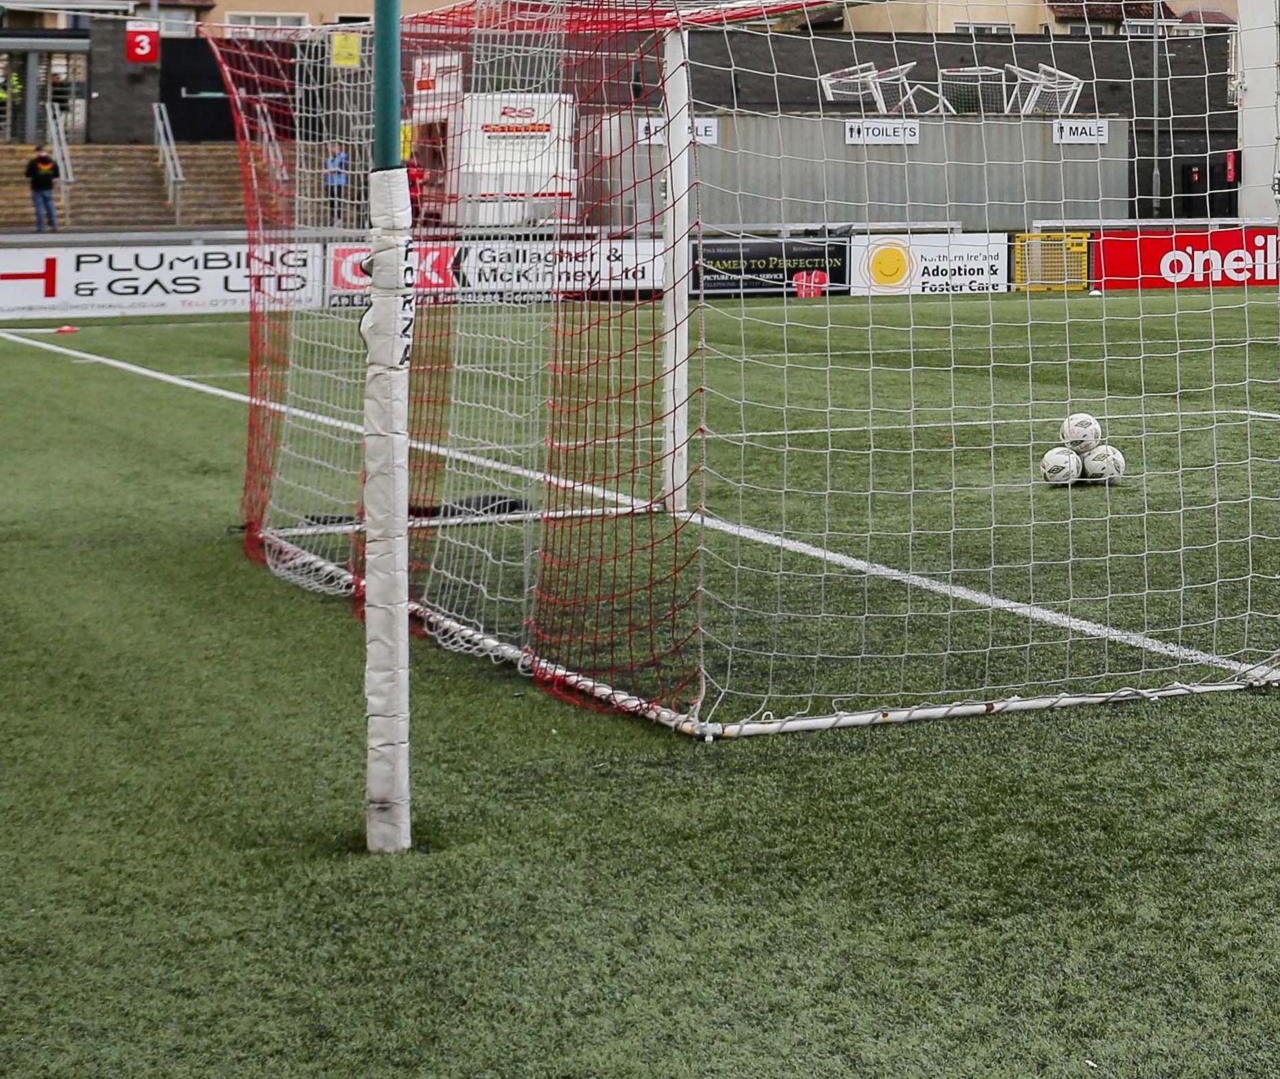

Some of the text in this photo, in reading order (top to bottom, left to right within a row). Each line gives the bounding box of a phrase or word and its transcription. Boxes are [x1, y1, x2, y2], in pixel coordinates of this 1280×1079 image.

[134, 34, 151, 56] 3
[654, 125, 712, 137] FLE
[864, 125, 917, 139] TOILETS
[1069, 125, 1104, 138] MALE
[477, 247, 623, 269] Gallagher &
[750, 259, 767, 269] TO
[341, 250, 444, 285] GK
[921, 265, 999, 279] Adoption &
[477, 265, 646, 290] McKinney Ltd
[75, 274, 308, 297] & GAS LTD
[921, 280, 1000, 293] Foster Care
